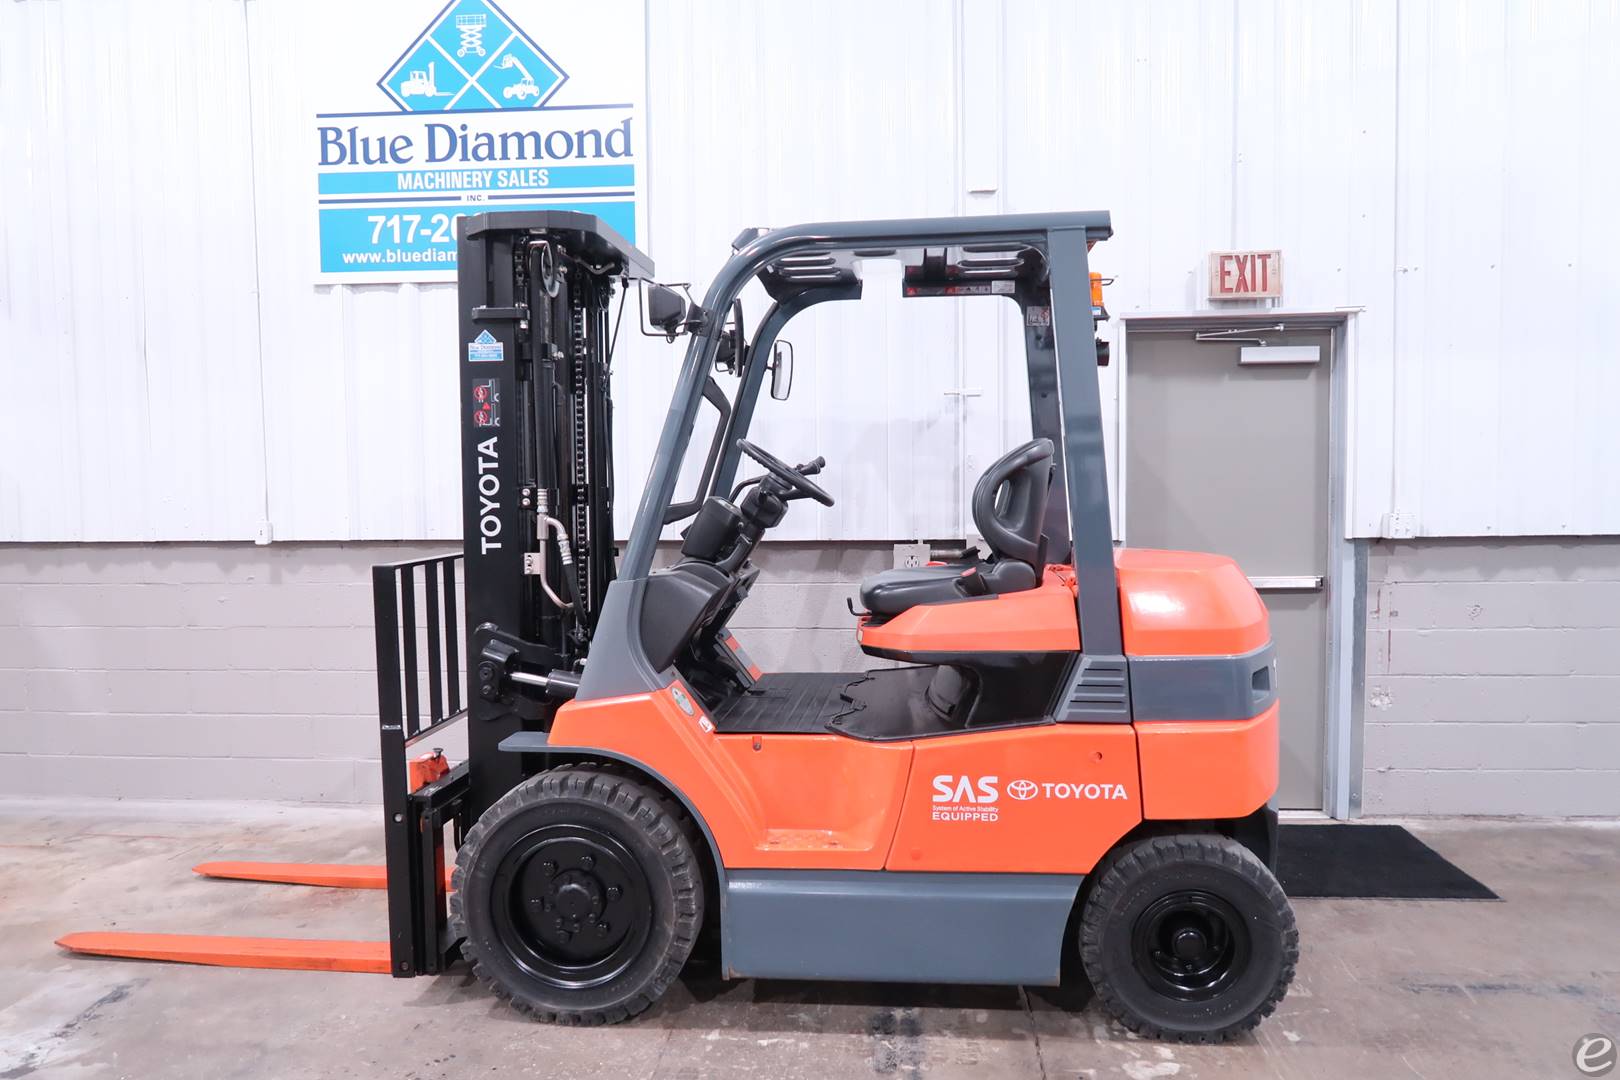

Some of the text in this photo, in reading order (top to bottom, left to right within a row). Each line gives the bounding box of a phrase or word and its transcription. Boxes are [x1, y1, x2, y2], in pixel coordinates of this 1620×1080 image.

[317, 116, 633, 167] Blue Diamond
[397, 168, 549, 191] MACHINERY SALES
[466, 194, 486, 202] INC.
[1219, 253, 1272, 293] EXIT
[477, 436, 503, 555] TOYOTA
[932, 774, 999, 803] SAS
[1042, 783, 1128, 800] TOYOTA
[932, 805, 952, 813] System
[977, 806, 999, 814] Stability
[932, 812, 999, 822] EQUIPPED
